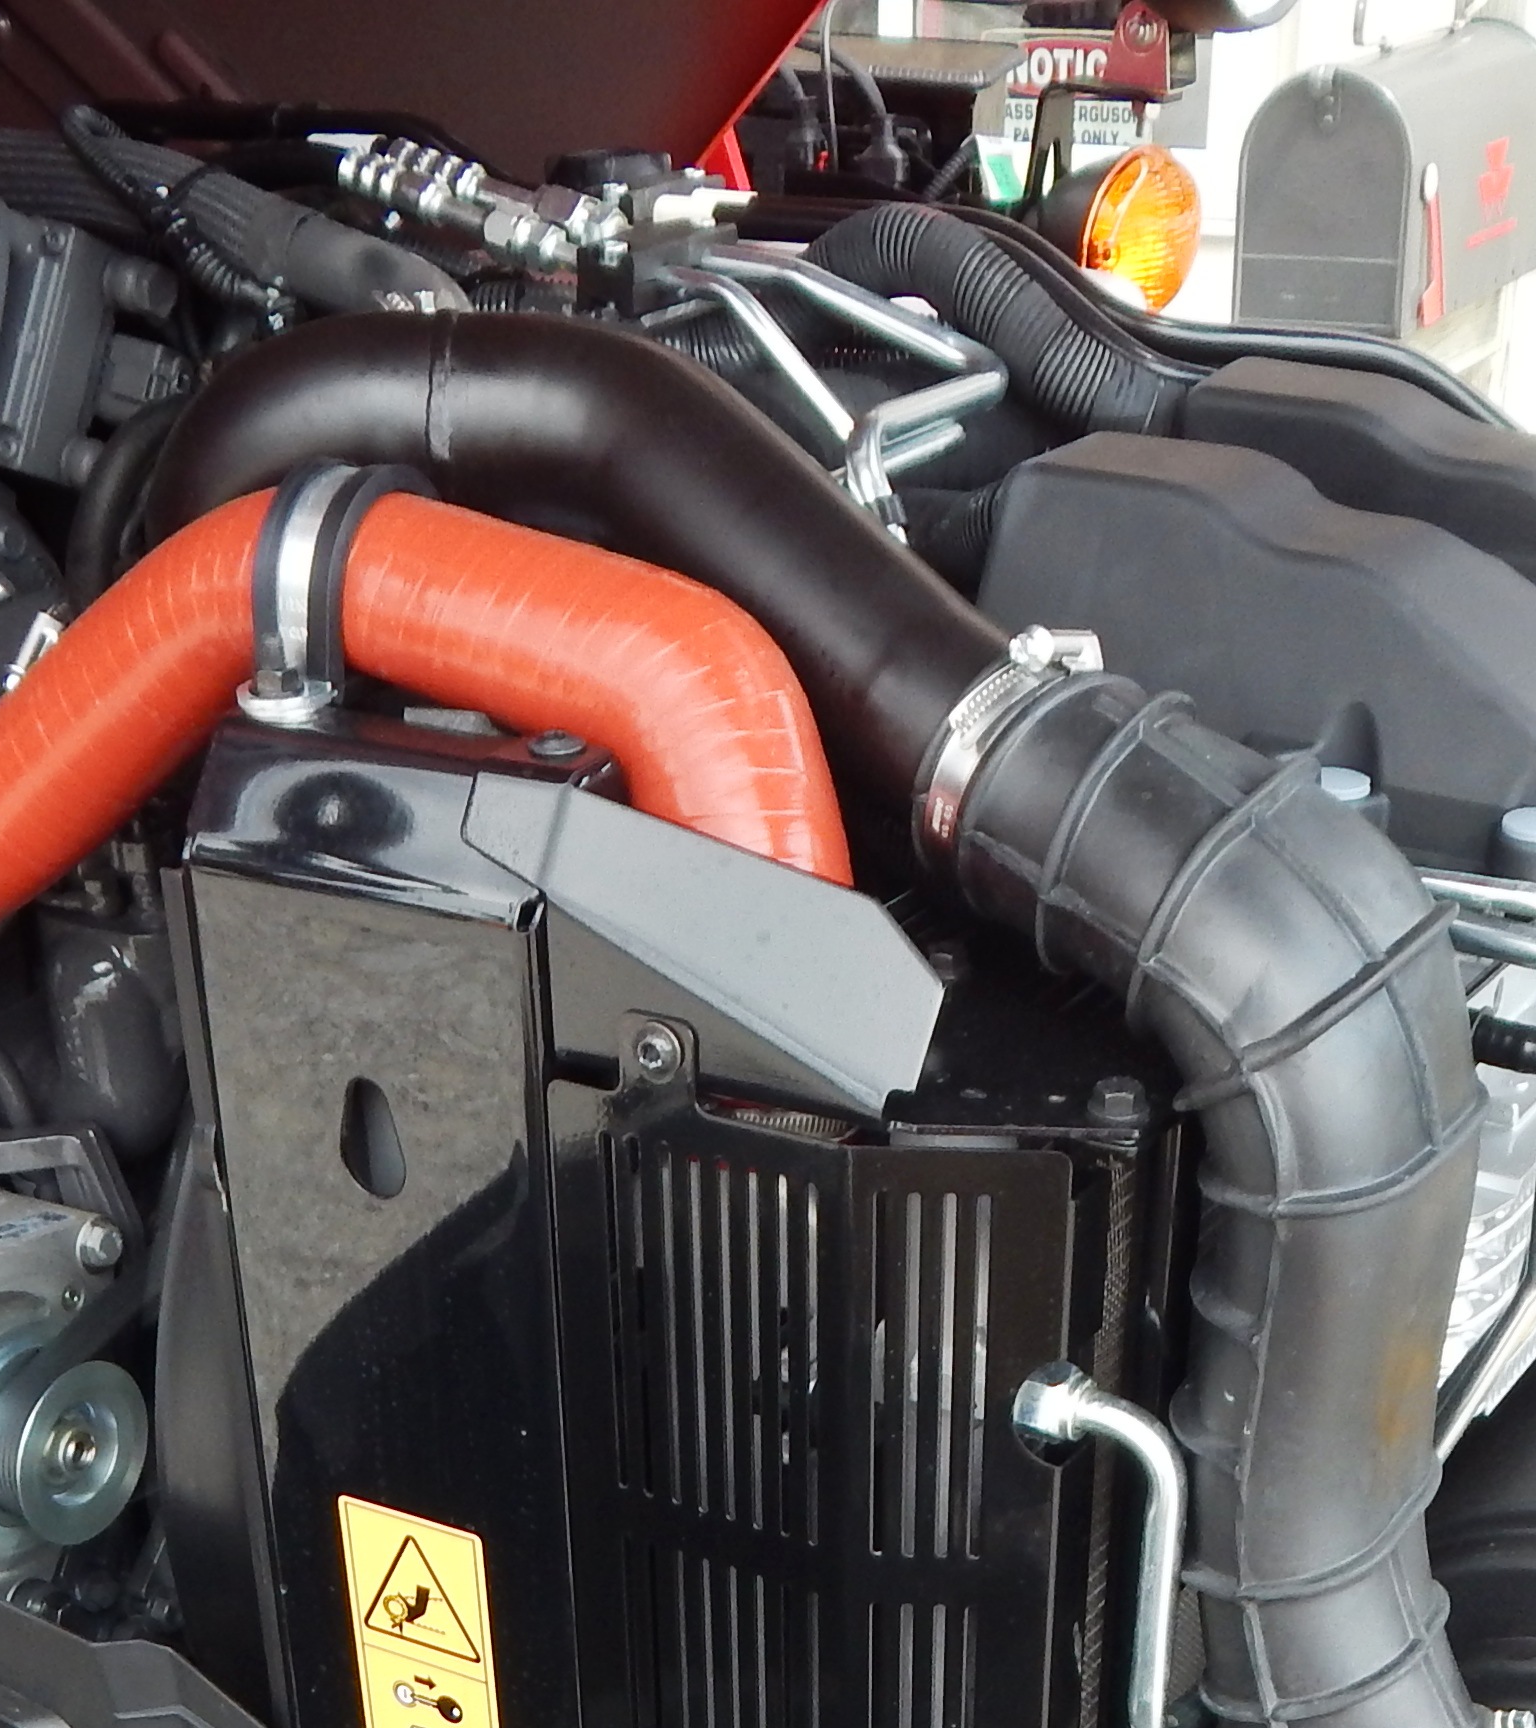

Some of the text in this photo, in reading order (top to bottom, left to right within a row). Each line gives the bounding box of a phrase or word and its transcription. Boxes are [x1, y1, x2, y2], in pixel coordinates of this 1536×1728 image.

[1006, 47, 1108, 85] NOTIC
[1005, 102, 1034, 120] ASS
[1080, 129, 1120, 146] ONLY
